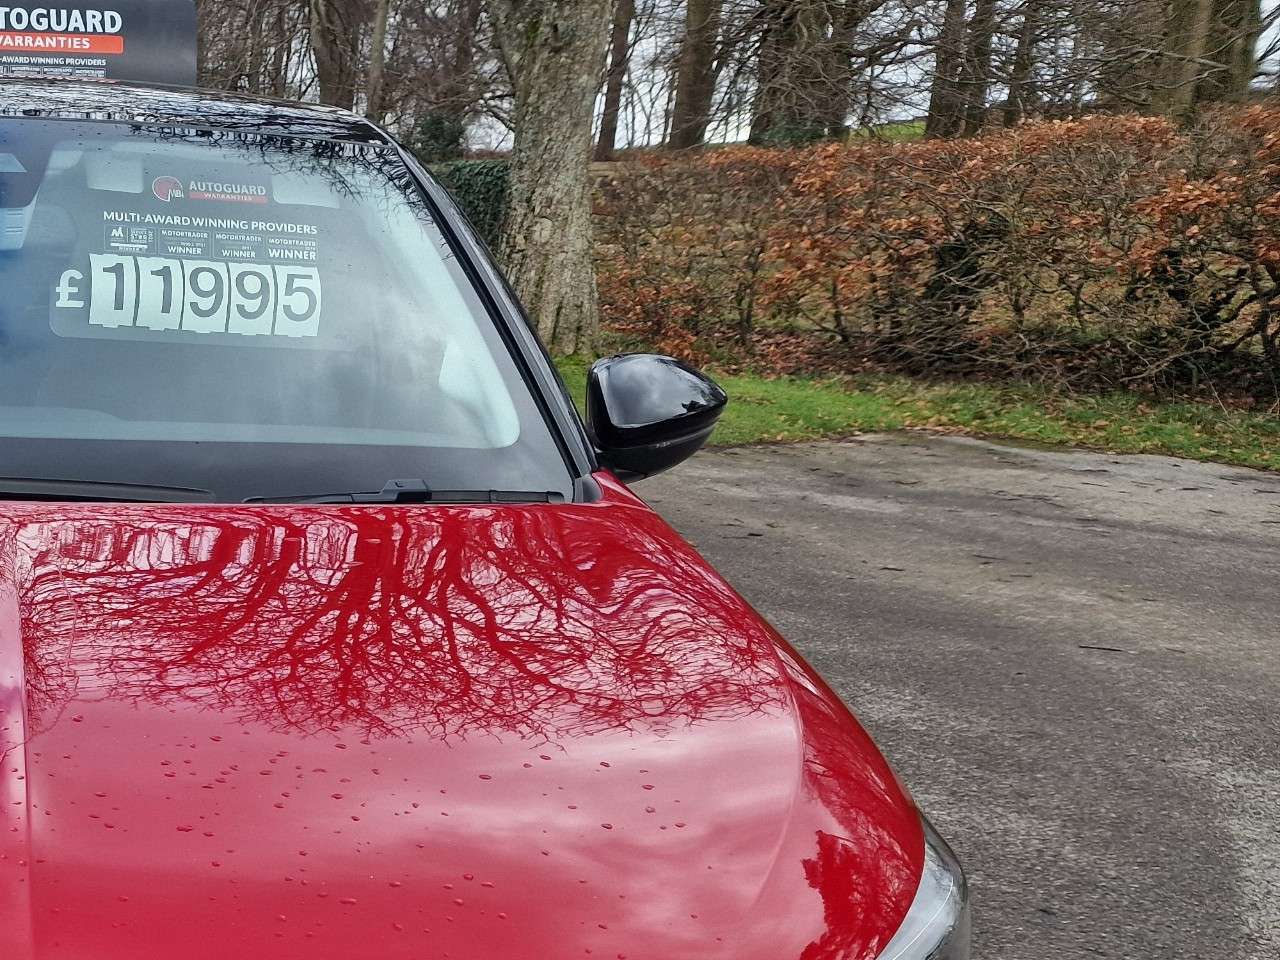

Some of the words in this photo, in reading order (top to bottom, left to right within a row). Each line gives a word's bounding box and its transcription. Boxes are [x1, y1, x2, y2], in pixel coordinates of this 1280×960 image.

[65, 58, 107, 66] PROVIDERS
[189, 181, 266, 196] AUTOGUARD
[103, 211, 190, 226] MULTI-AWARD
[192, 217, 249, 230] WINNING
[251, 221, 318, 235] PROVIDERS
[167, 246, 202, 255] WINNER
[221, 249, 256, 258] WINNER
[268, 249, 316, 260] WINNER
